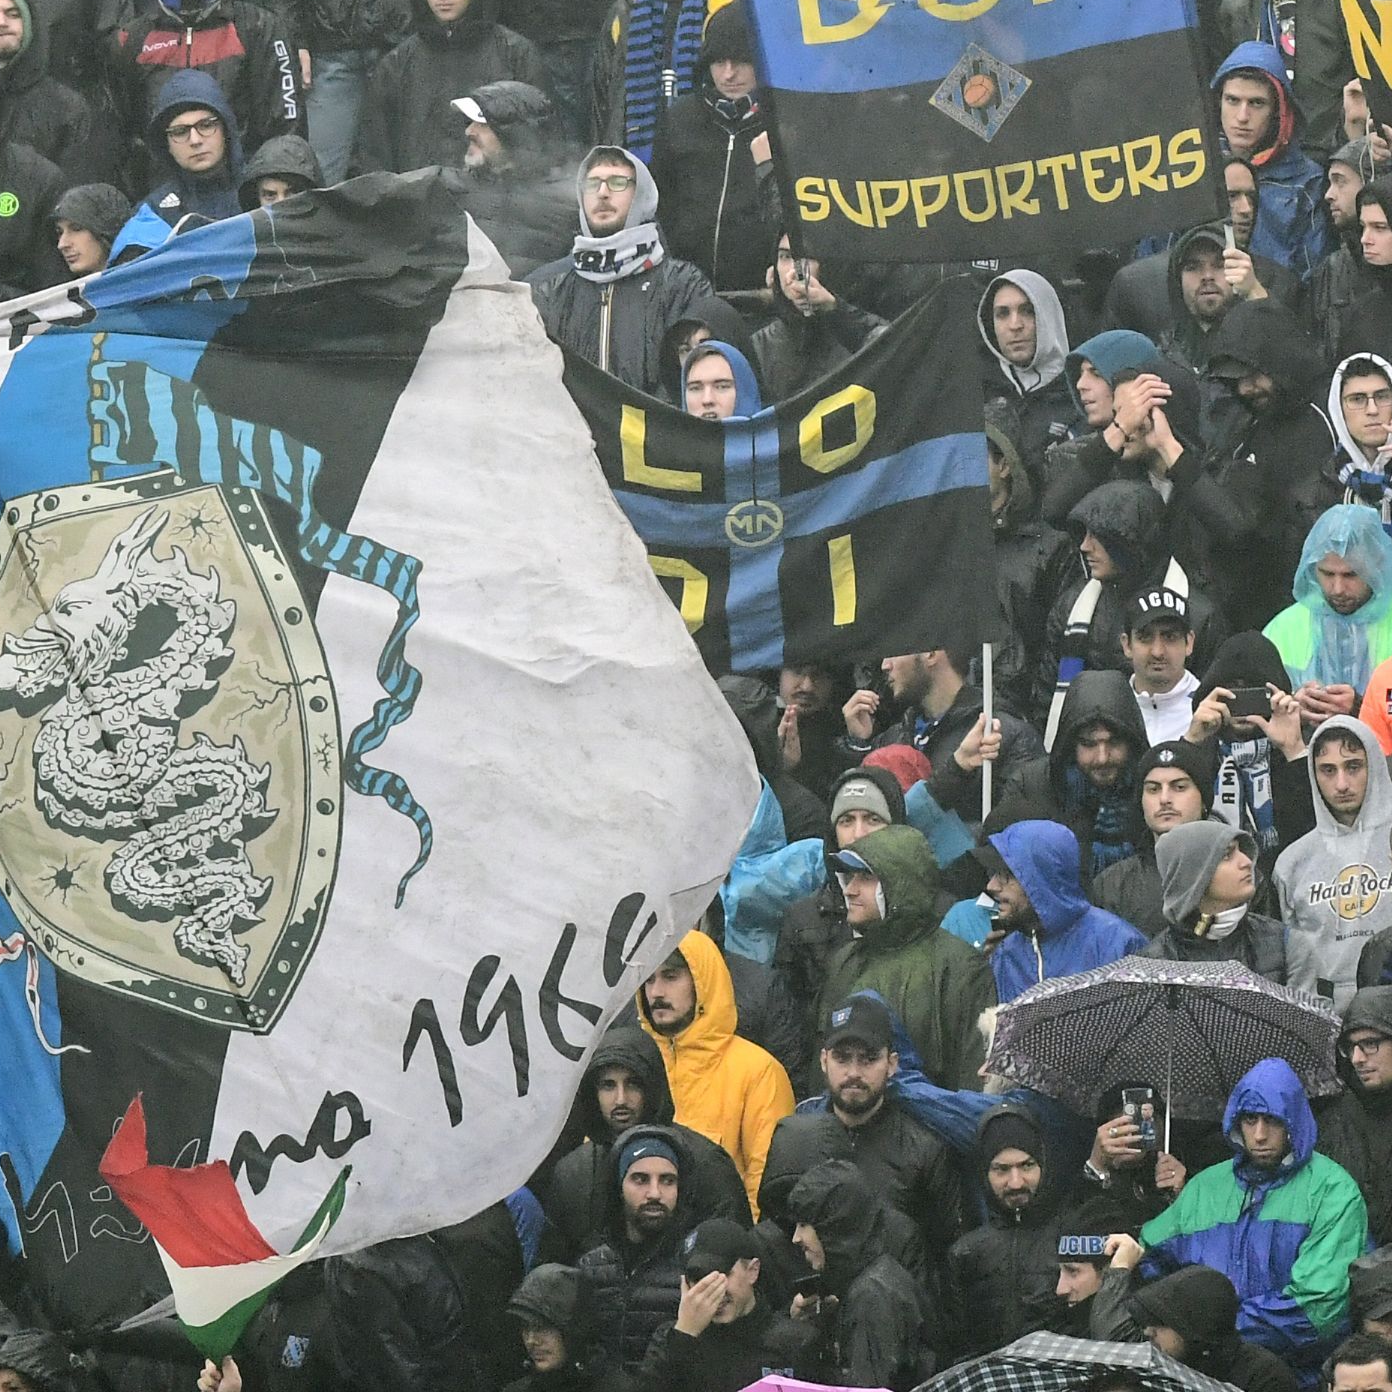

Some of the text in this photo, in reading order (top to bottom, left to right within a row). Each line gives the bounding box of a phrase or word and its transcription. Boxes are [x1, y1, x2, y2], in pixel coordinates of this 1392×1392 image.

[273, 39, 298, 120] GIVOVA
[794, 127, 1207, 230] SUPPORTERS
[1138, 591, 1186, 617] ICON
[1308, 876, 1355, 906] Hard
